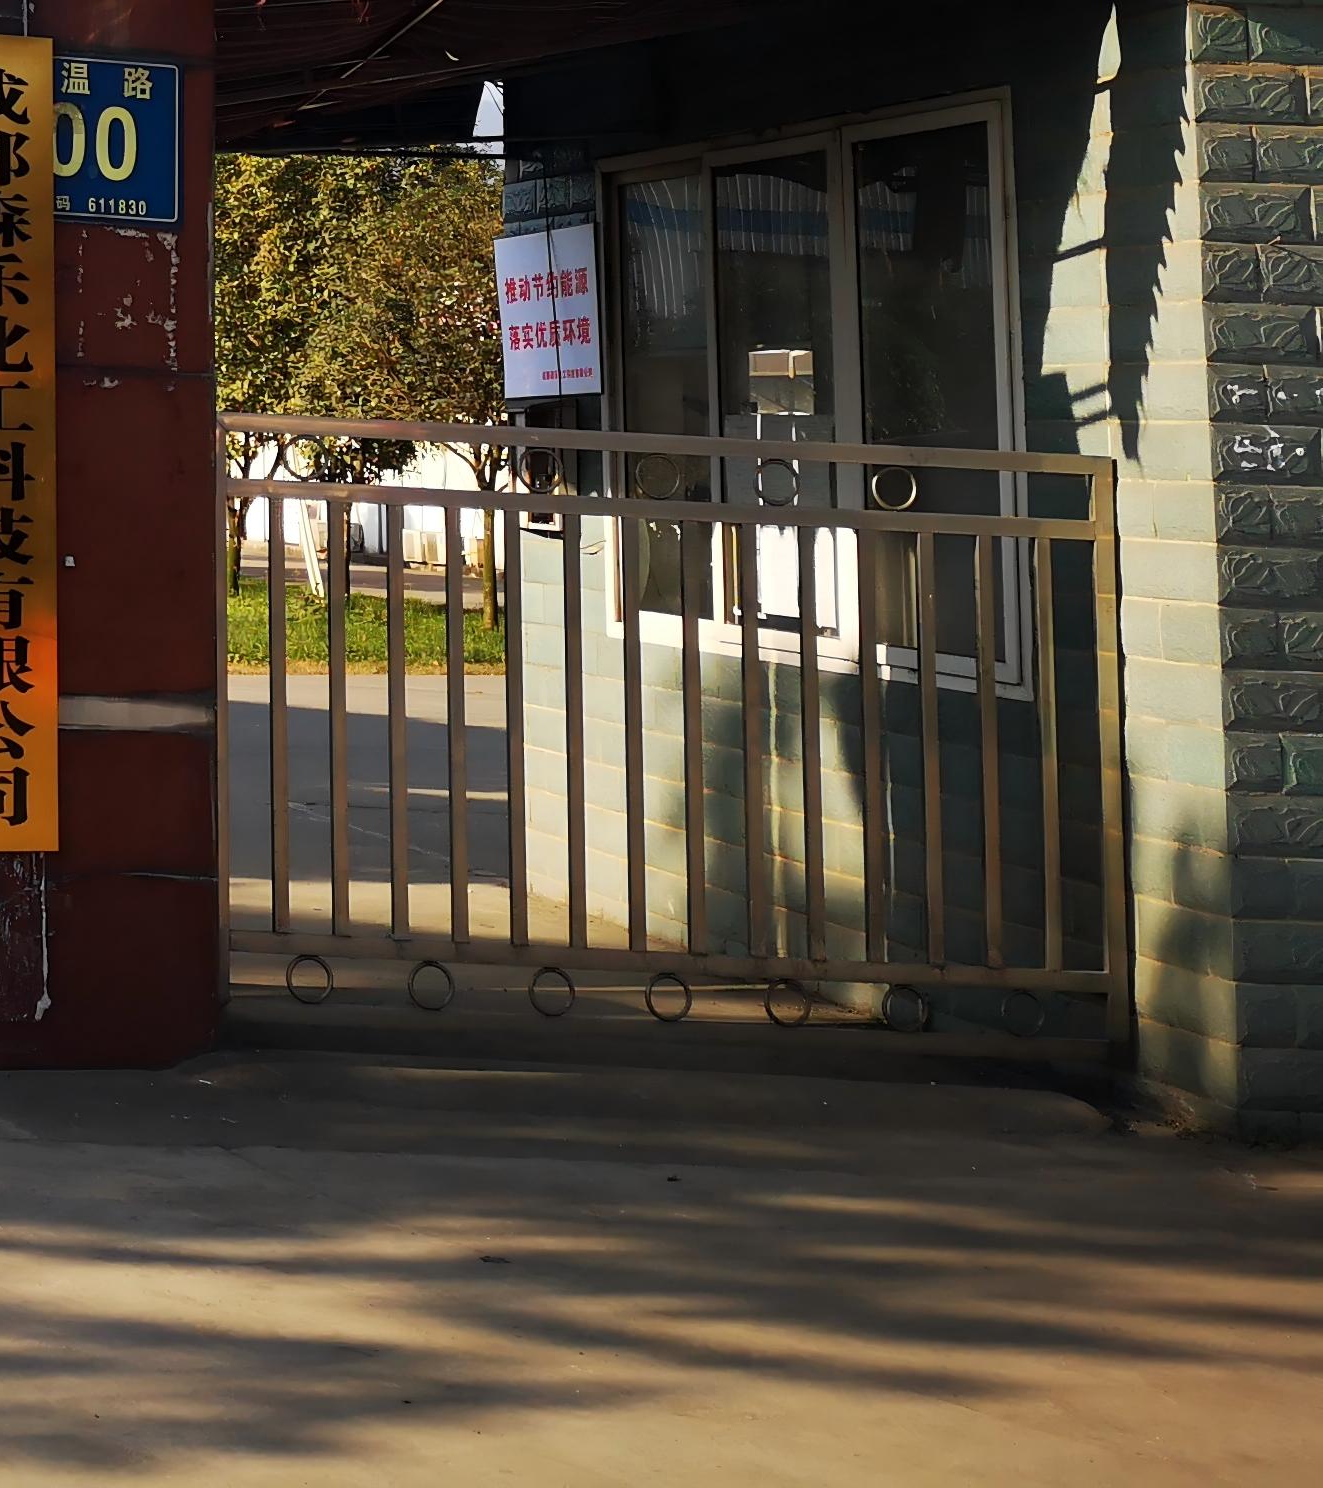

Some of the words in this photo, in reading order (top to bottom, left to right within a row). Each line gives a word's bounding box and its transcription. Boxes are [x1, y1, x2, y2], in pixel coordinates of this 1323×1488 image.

[88, 197, 147, 215] 611830
[505, 267, 589, 305] 推动节约能源
[509, 315, 592, 351] 落实优质环境
